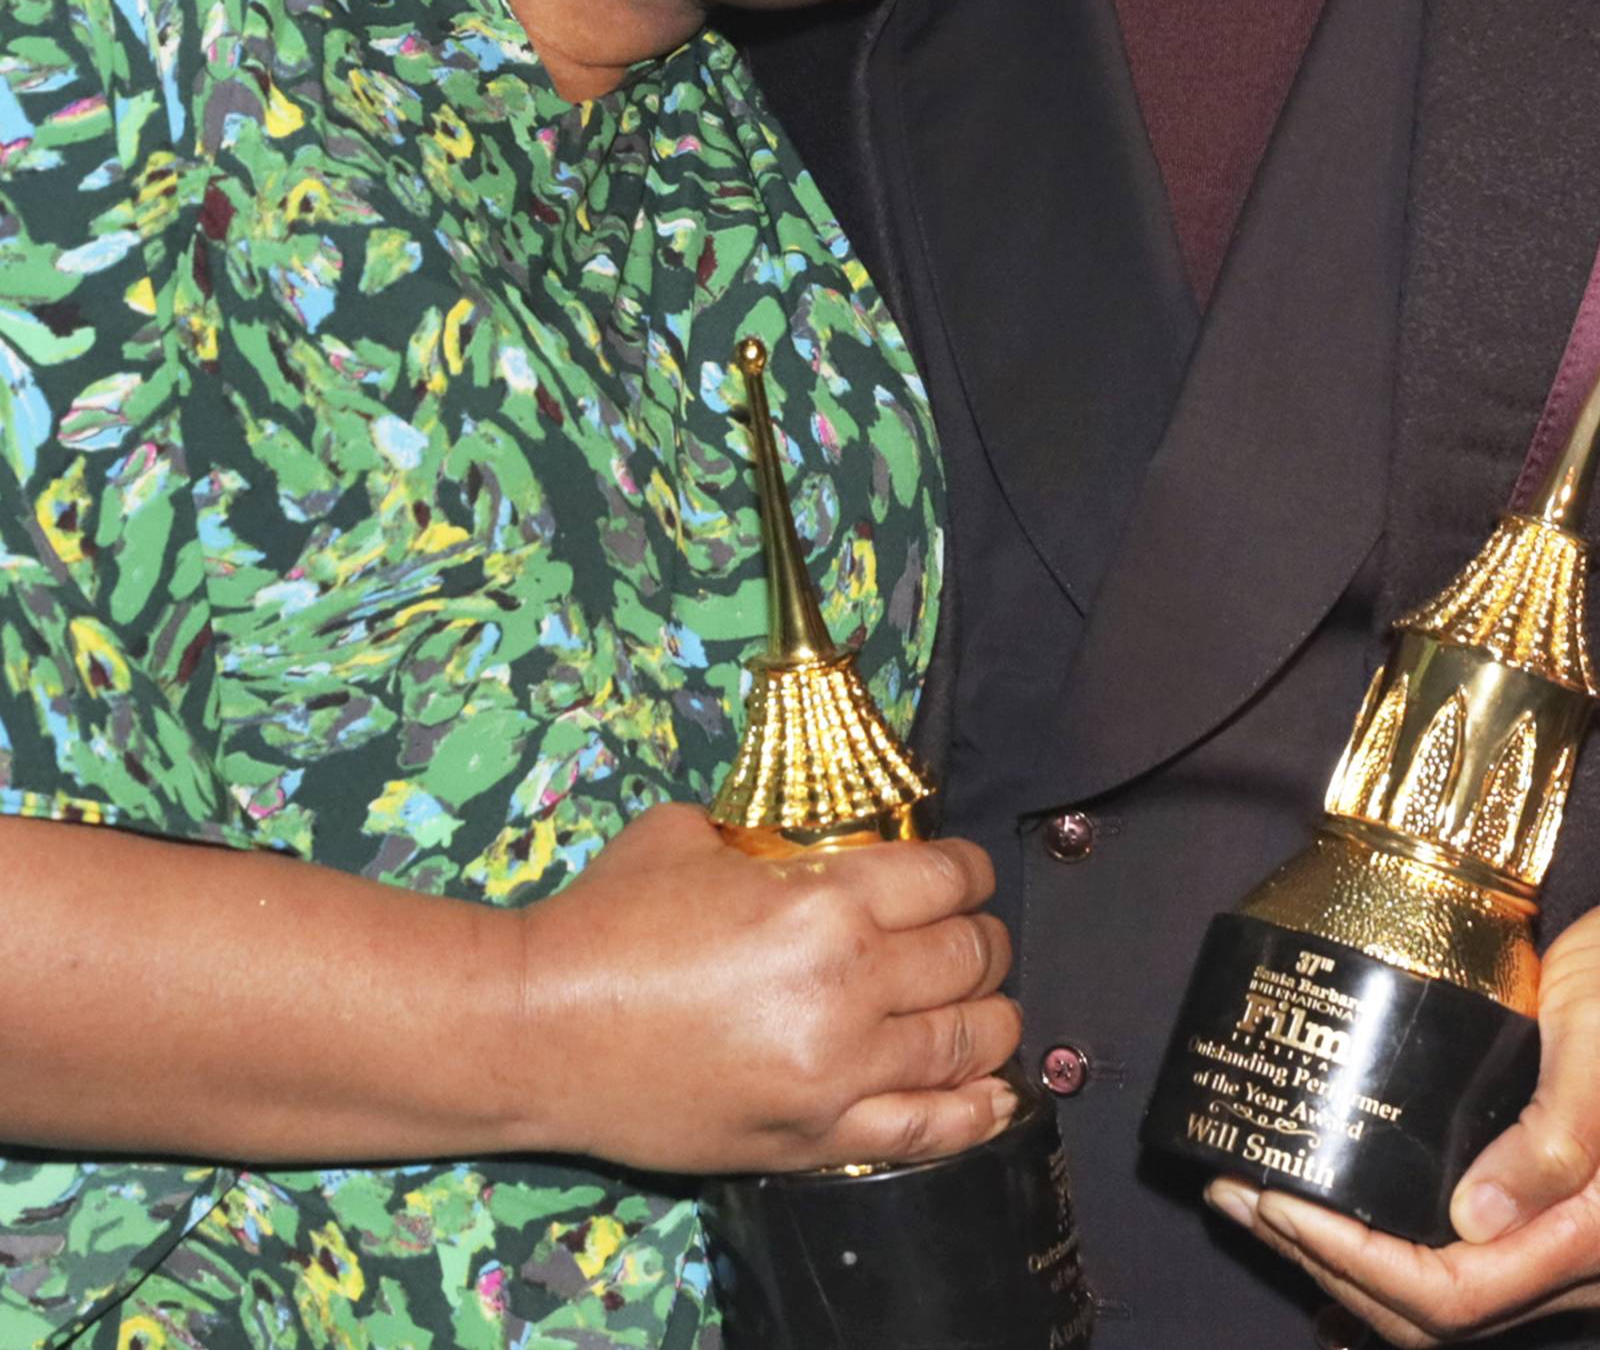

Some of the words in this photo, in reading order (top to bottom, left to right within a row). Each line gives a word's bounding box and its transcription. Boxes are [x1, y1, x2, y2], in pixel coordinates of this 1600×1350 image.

[1253, 965, 1296, 988] Santa
[1236, 992, 1354, 1067] Film
[1188, 1034, 1289, 1087] Outstanding
[1211, 1071, 1240, 1096] the
[1244, 1082, 1288, 1113] Year
[1187, 1113, 1240, 1152] Will
[1242, 1133, 1336, 1188] Smith
